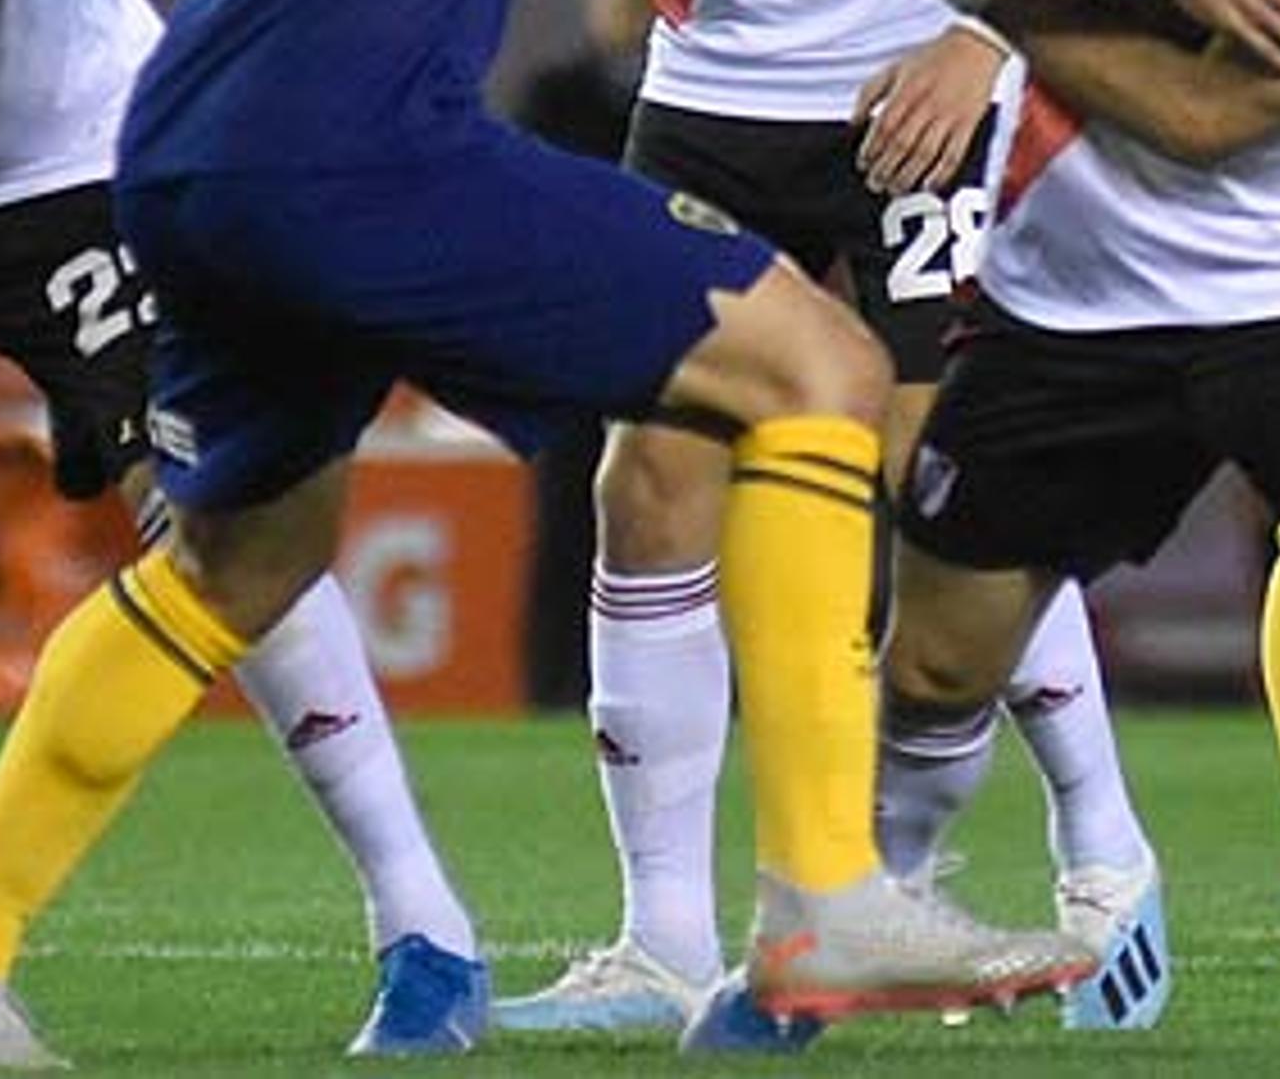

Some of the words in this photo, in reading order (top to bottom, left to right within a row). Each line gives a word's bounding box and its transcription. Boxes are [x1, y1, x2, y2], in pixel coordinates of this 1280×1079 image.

[46, 243, 158, 357] 2
[882, 187, 992, 303] 28
[347, 513, 454, 677] G
